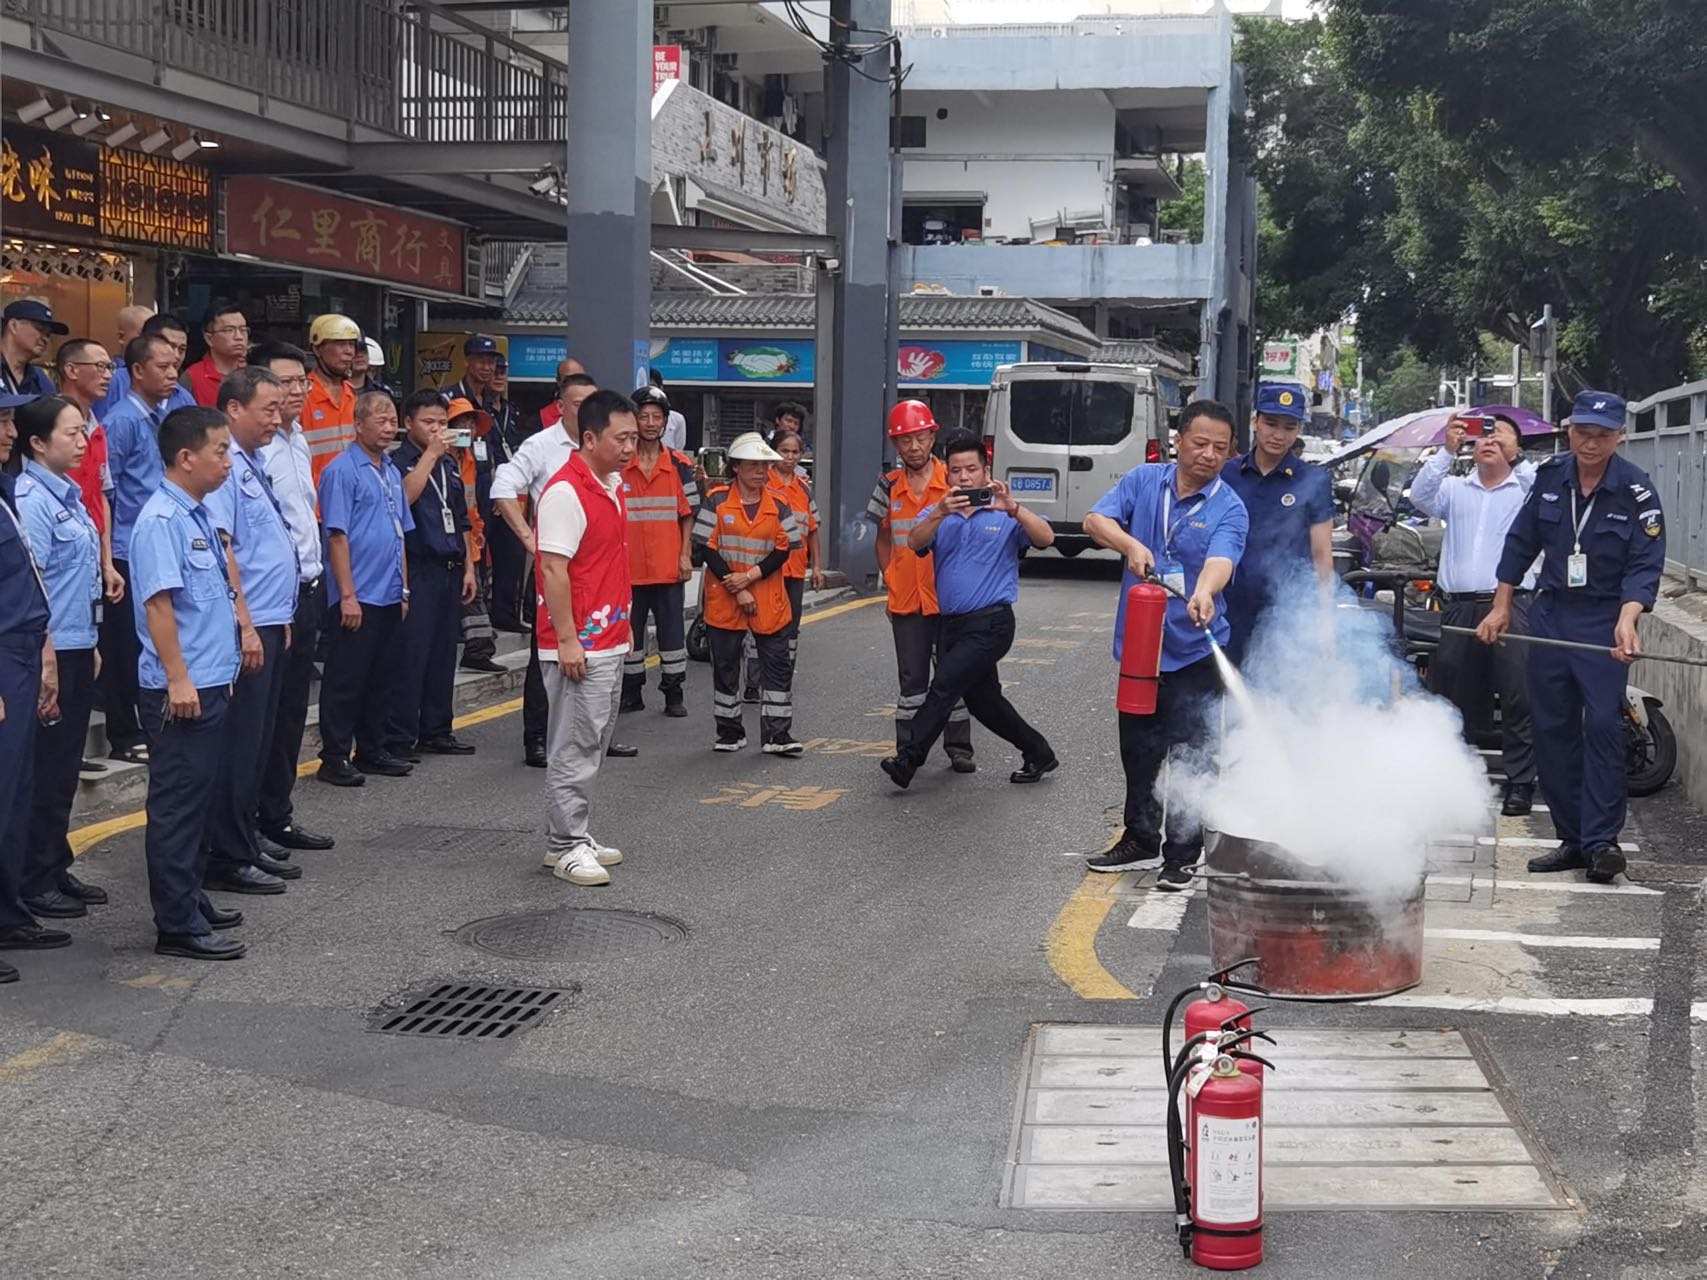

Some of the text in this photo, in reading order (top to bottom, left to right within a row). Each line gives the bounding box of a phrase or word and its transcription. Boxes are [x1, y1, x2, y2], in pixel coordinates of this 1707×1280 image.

[655, 52, 666, 61] BE
[655, 62, 677, 71] YOUR
[253, 196, 429, 274] 仁里商行
